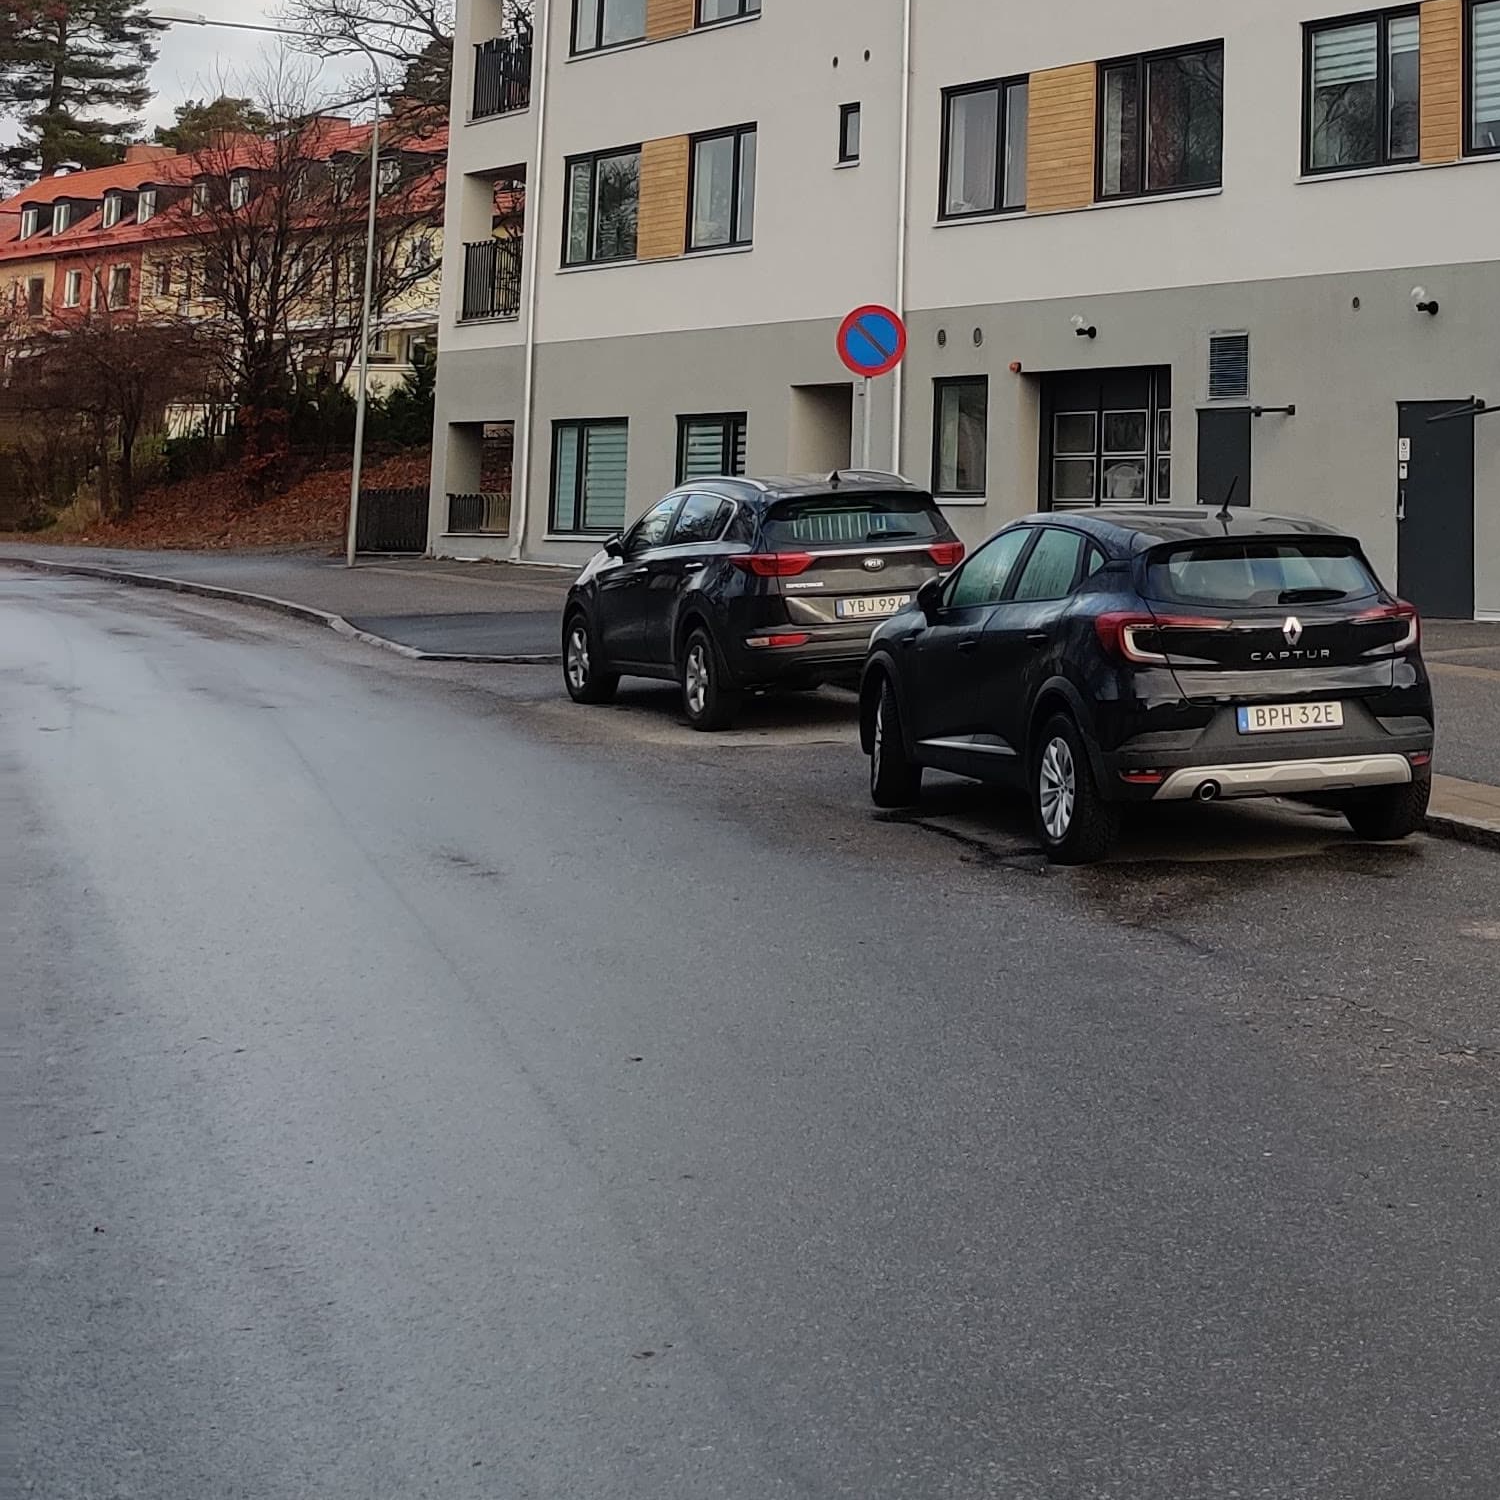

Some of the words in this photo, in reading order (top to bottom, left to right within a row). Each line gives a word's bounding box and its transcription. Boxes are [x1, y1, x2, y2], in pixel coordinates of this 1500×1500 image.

[849, 599, 876, 612] YBJ
[1250, 649, 1330, 661] CAPTUR
[1255, 707, 1293, 727] BPH
[1299, 704, 1335, 724] 32E
